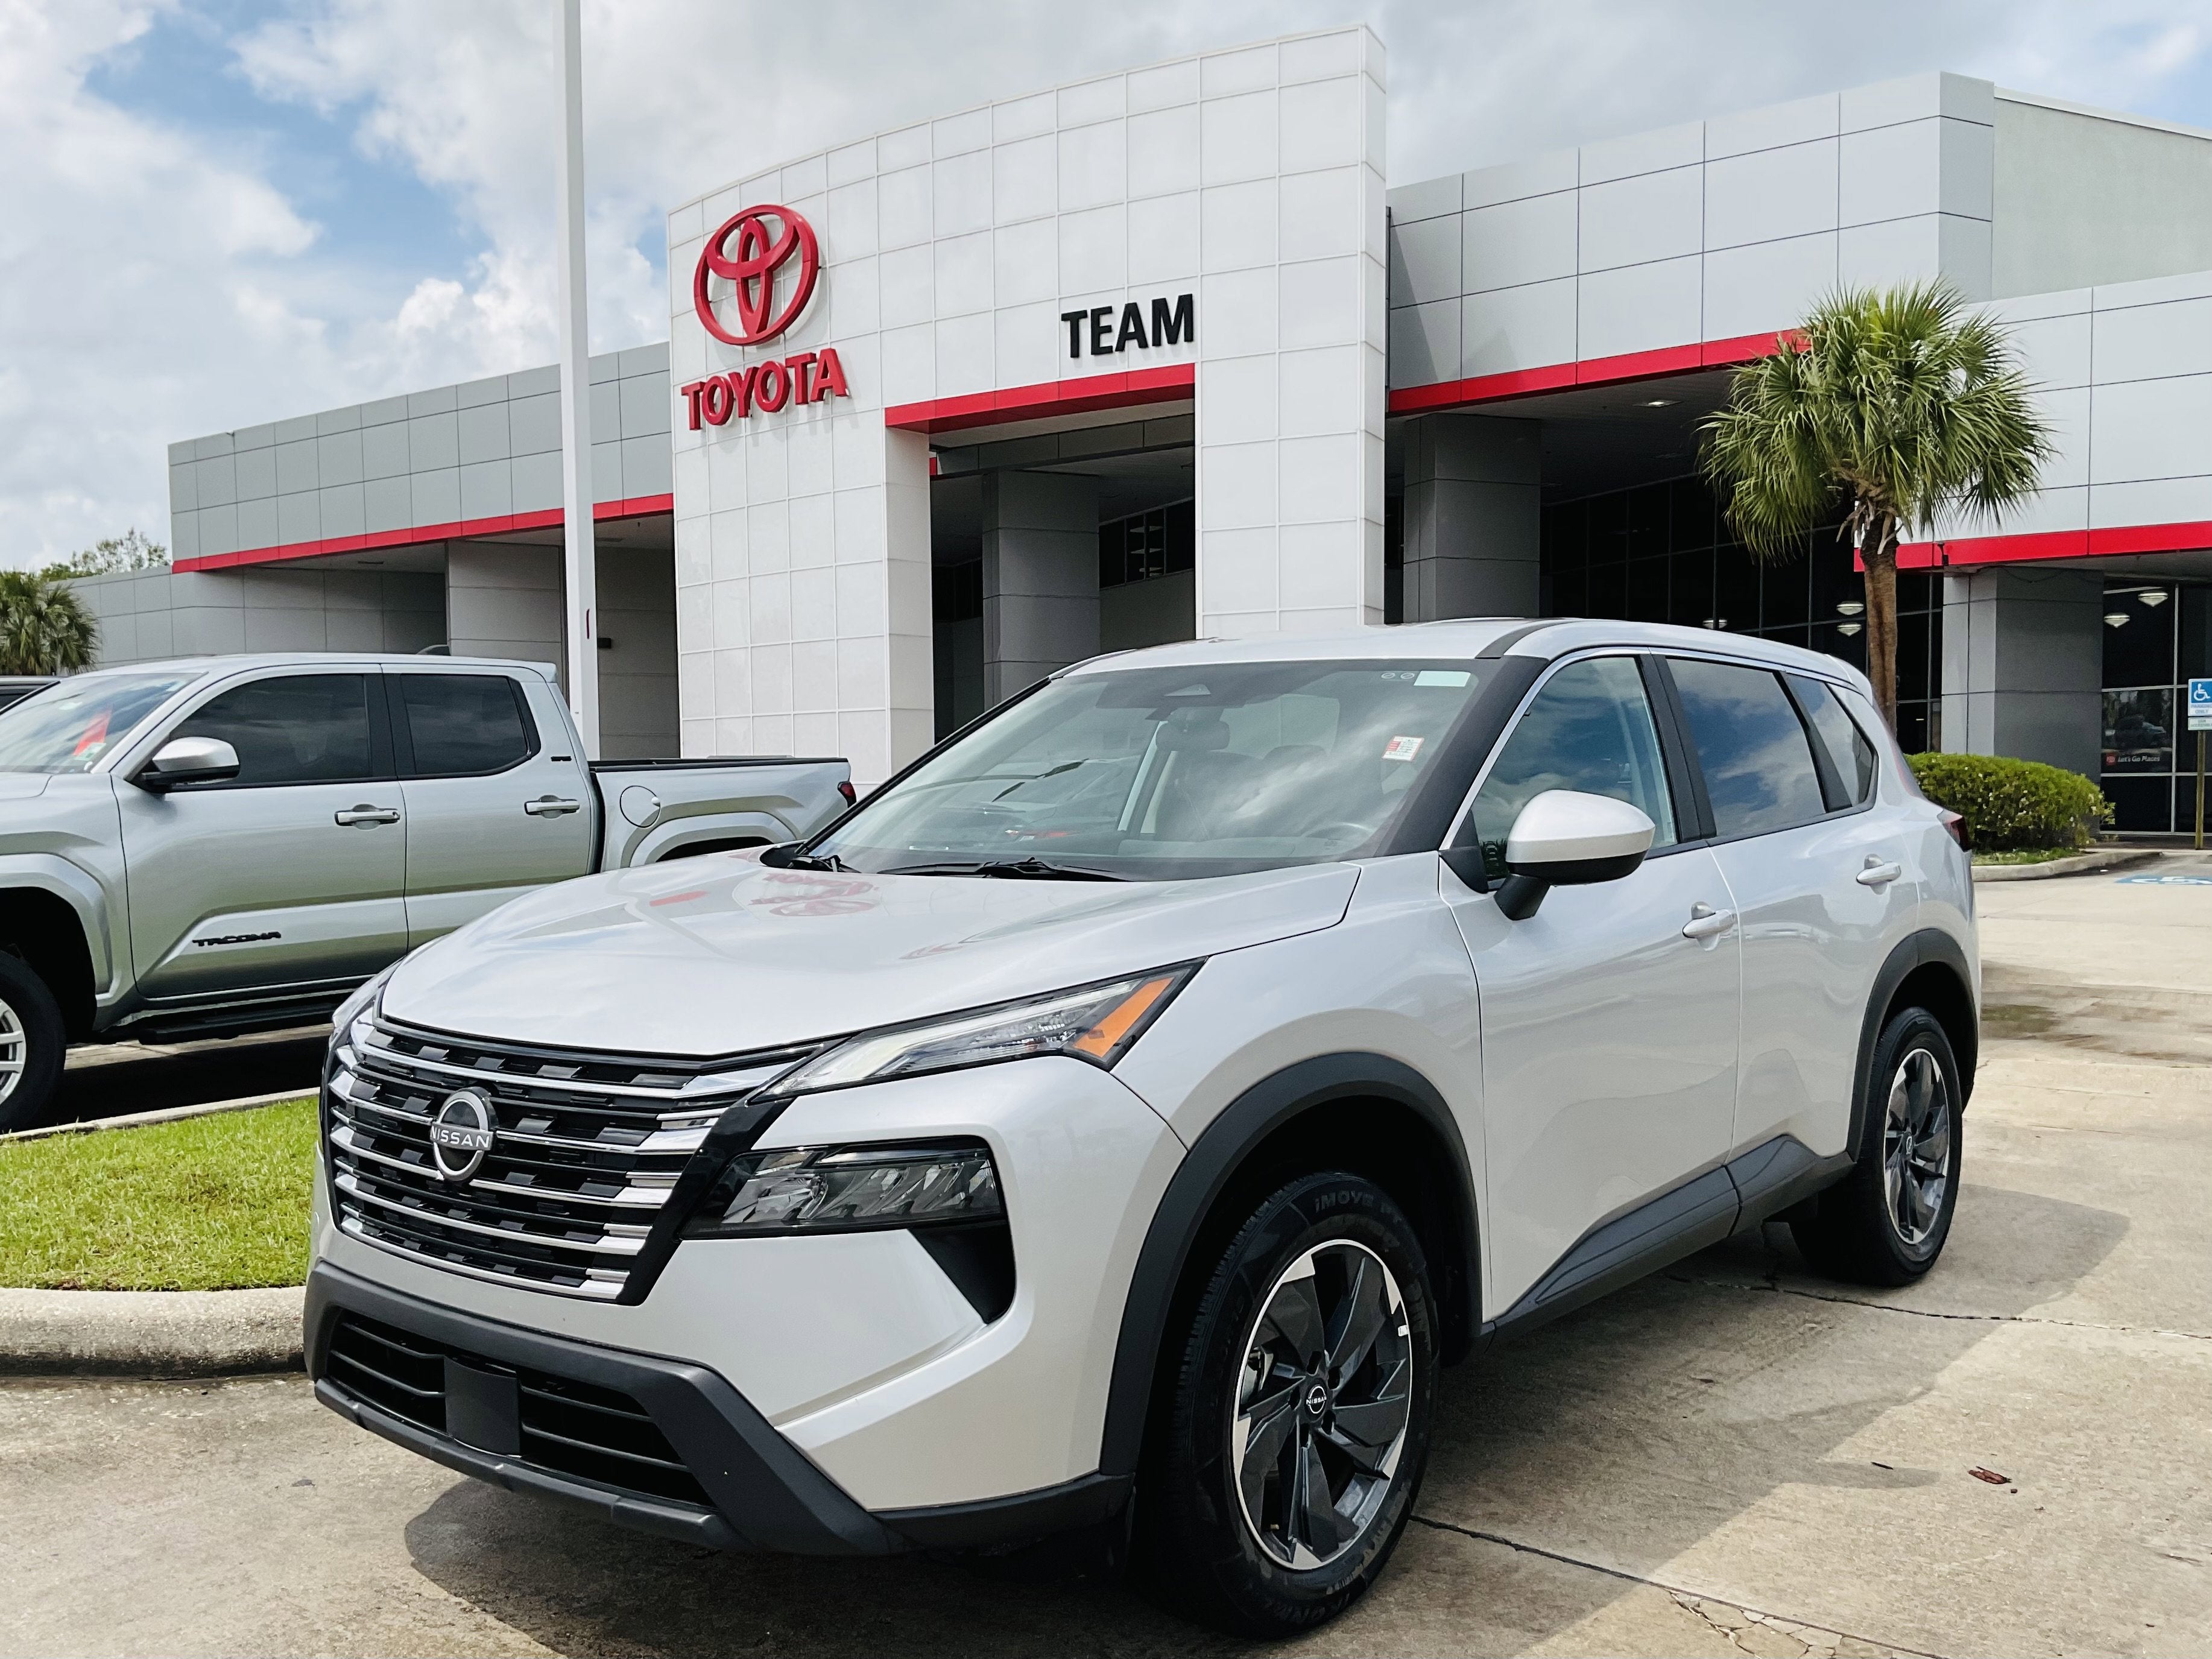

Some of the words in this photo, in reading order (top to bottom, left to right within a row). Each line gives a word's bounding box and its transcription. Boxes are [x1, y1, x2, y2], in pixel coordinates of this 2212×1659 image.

[1061, 294, 1193, 358] TEAM
[681, 348, 848, 430] TOYOTA
[192, 931, 282, 947] TACOMA
[429, 1125, 490, 1148] NISSAN
[1306, 1395, 1327, 1405] NISSAN
